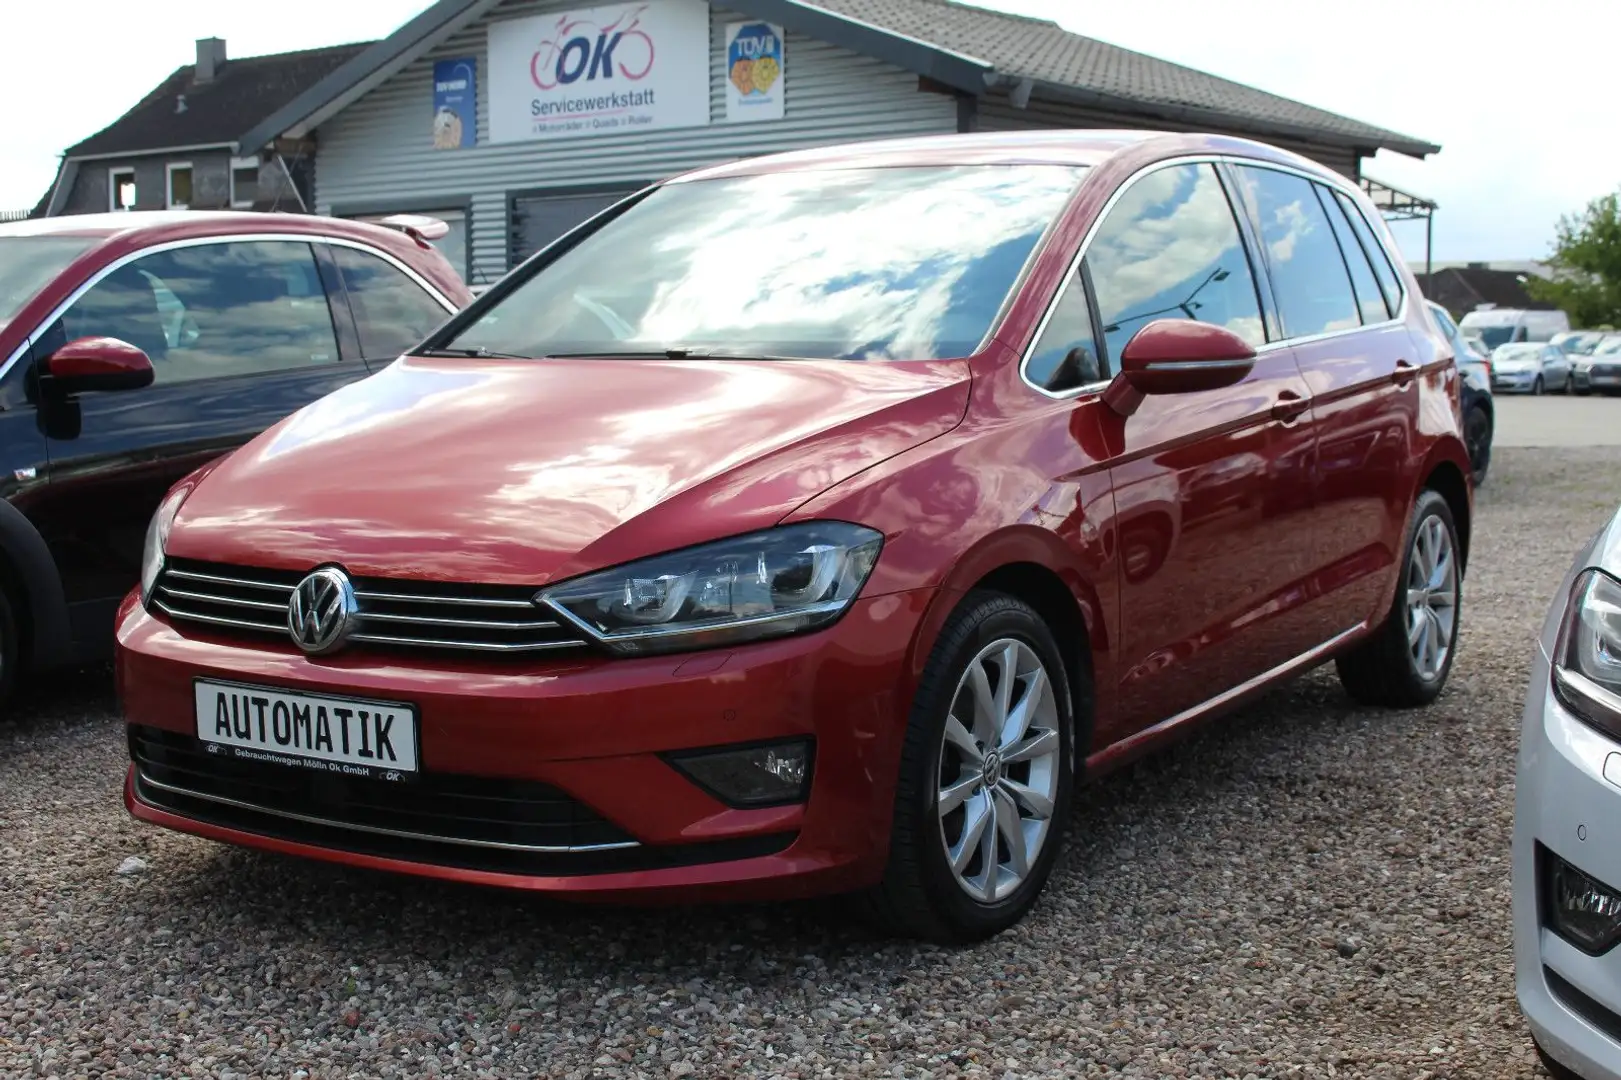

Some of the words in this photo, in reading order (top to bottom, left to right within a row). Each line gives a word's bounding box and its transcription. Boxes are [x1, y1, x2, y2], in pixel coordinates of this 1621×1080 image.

[556, 31, 623, 84] OK
[531, 88, 655, 116] Servicewerkstatt
[215, 692, 397, 761] AUTOMATIK
[234, 748, 302, 766] Gebrauchtwagen
[303, 759, 327, 770] Mölln
[342, 765, 370, 776] GmbH
[386, 771, 401, 782] OK
